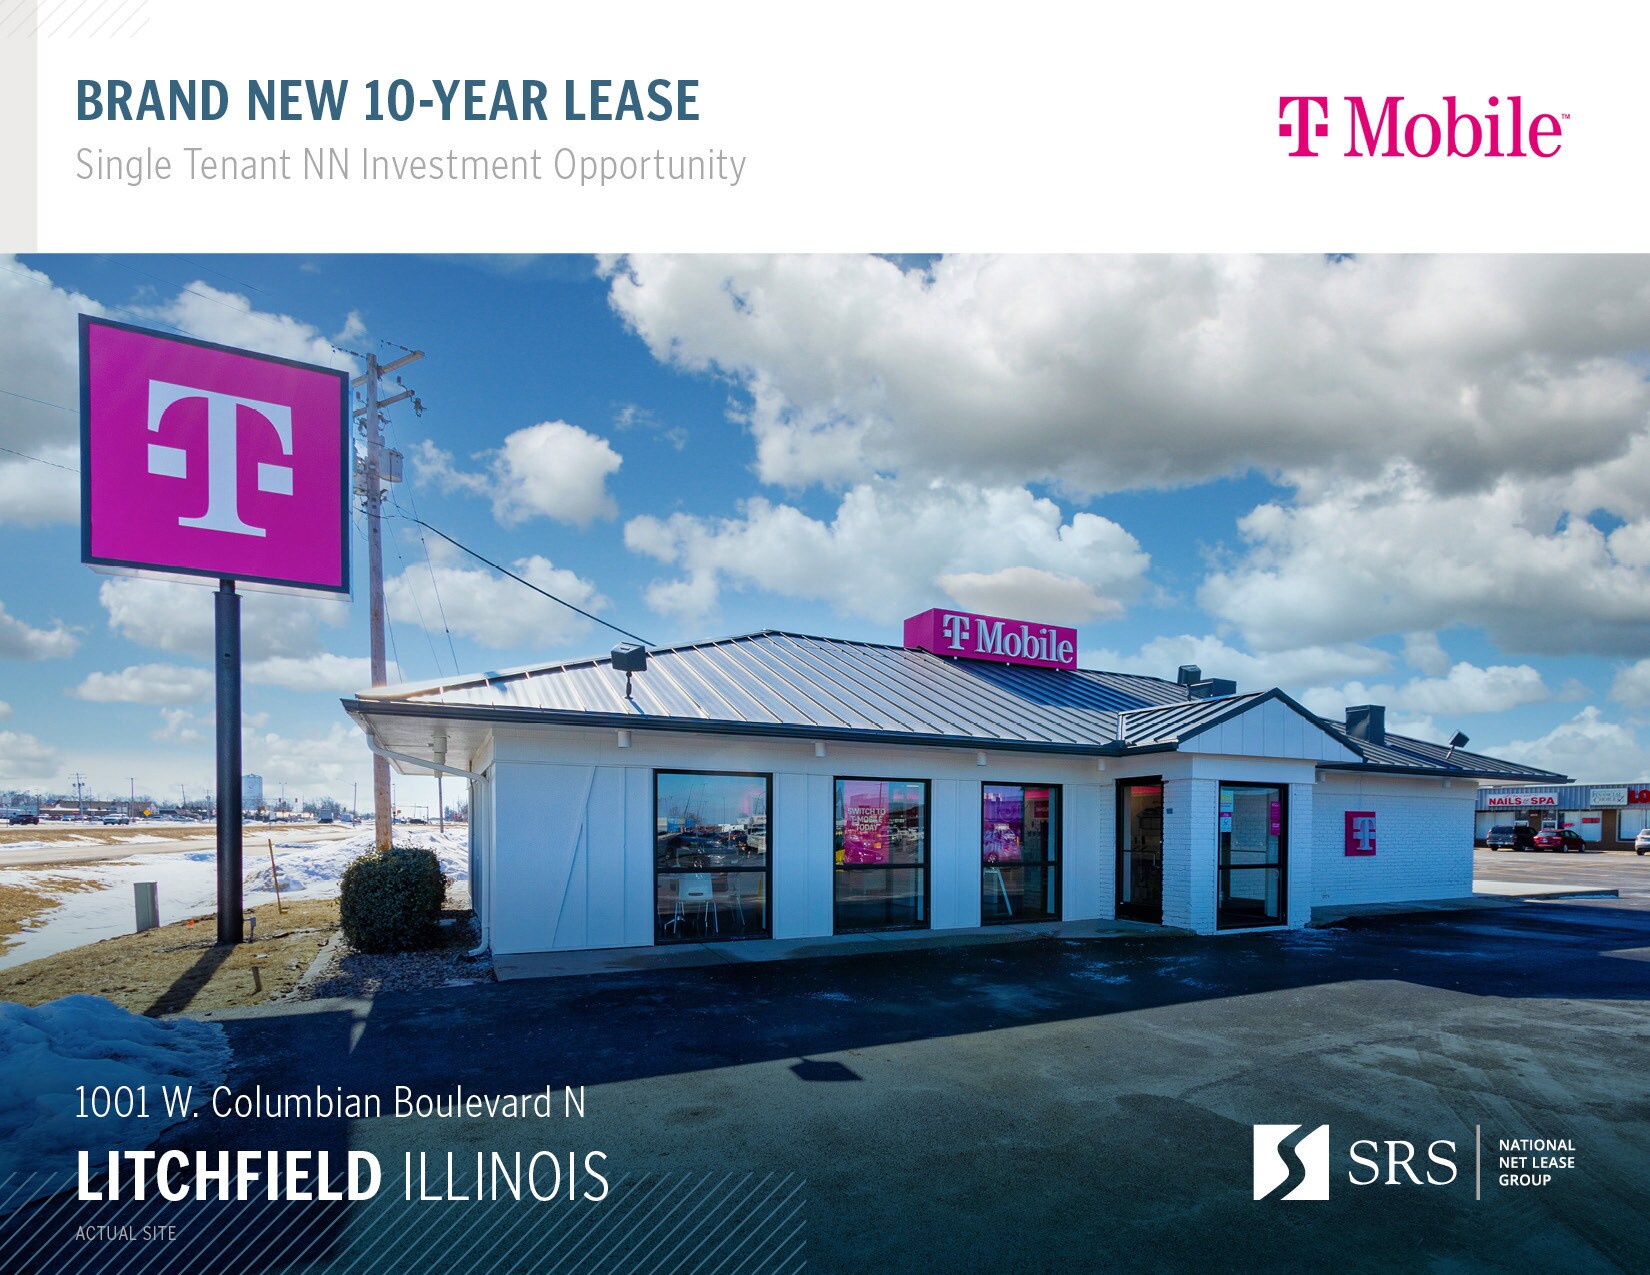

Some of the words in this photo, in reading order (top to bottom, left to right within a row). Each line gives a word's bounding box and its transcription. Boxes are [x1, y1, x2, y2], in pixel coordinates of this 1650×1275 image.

[1489, 797, 1521, 805] NAILS
[1531, 797, 1555, 805] SPA
[855, 823, 878, 831] TODAY
